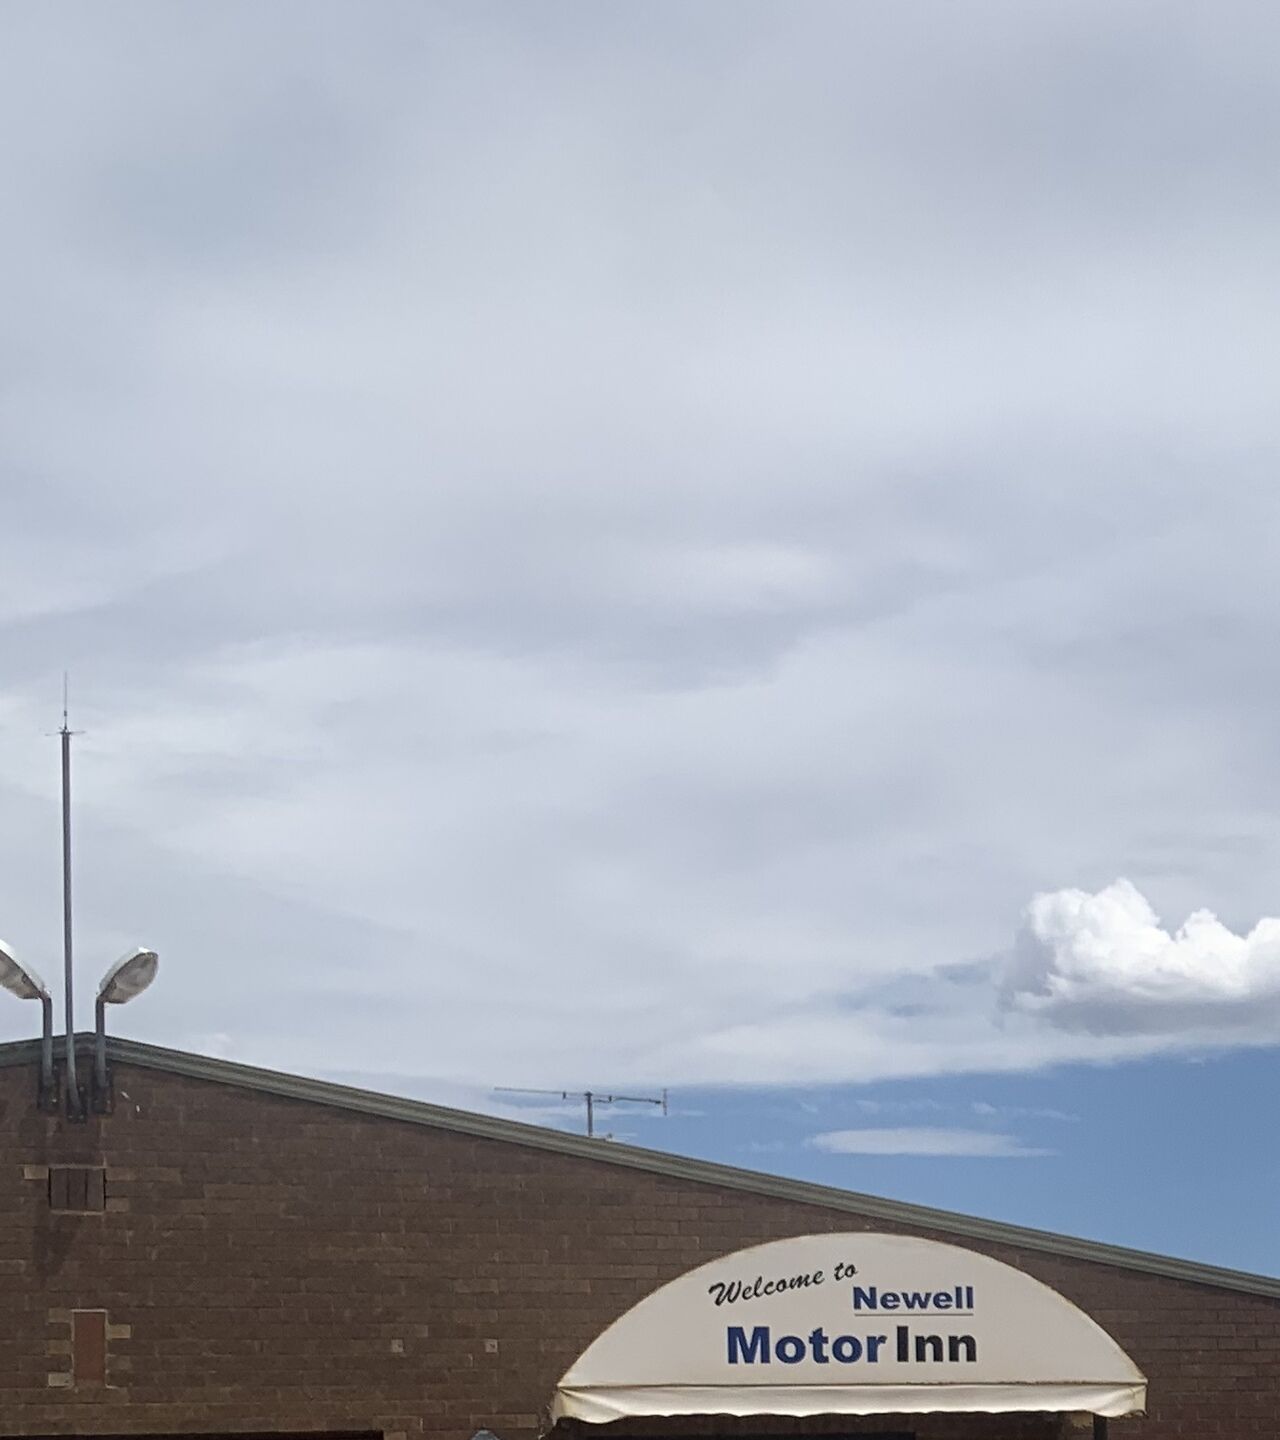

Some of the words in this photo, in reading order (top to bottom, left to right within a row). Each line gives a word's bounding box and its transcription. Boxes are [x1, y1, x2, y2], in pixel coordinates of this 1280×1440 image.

[708, 1270, 825, 1307] Welcome
[833, 1262, 859, 1282] to
[853, 1286, 974, 1310] Newell
[727, 1326, 888, 1365] Motor
[896, 1325, 977, 1363] Inn
